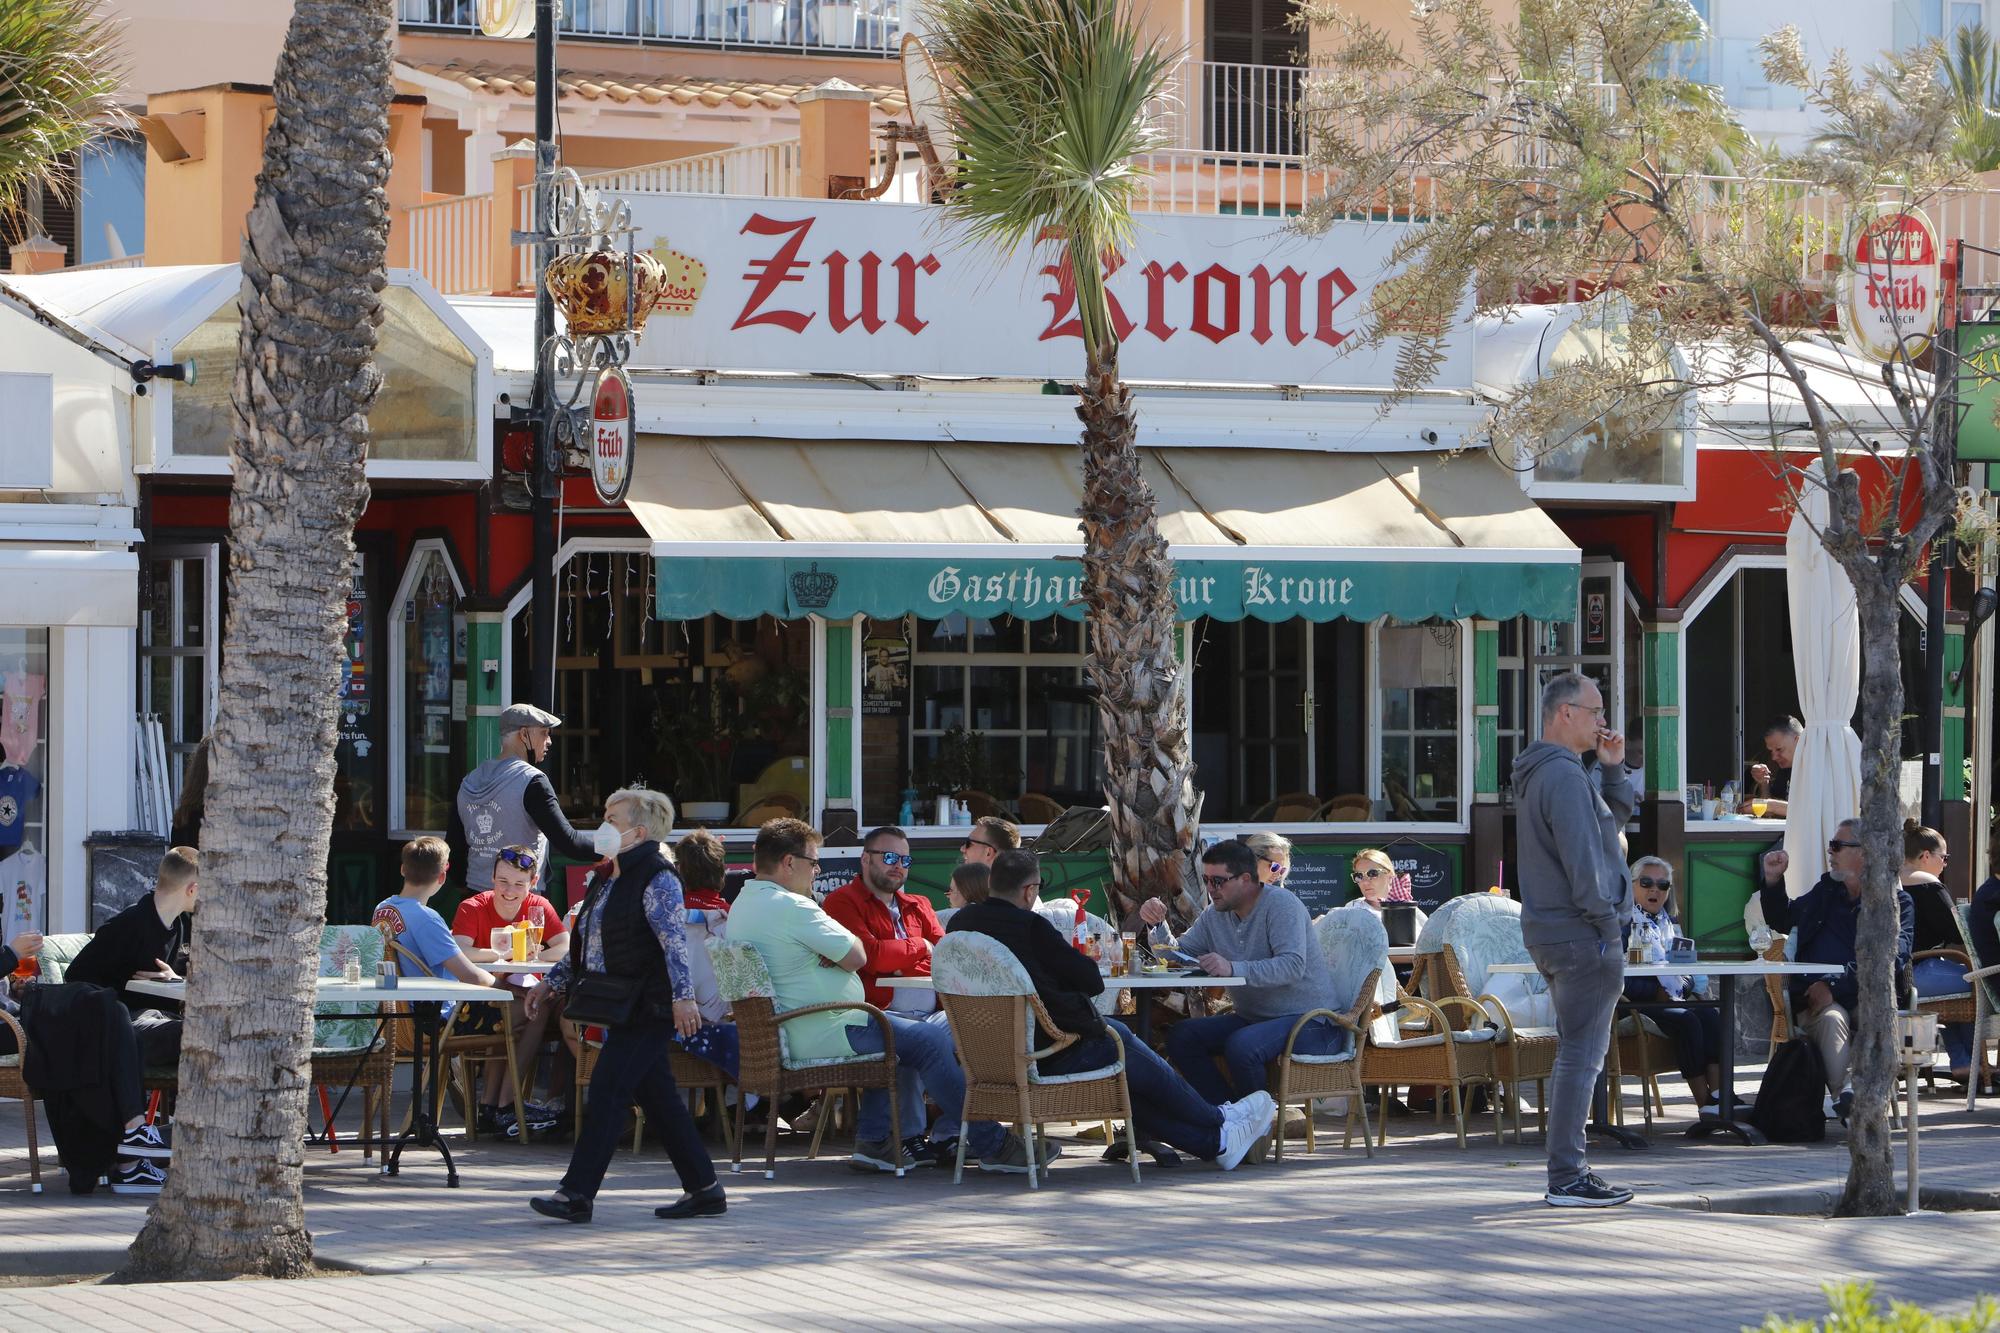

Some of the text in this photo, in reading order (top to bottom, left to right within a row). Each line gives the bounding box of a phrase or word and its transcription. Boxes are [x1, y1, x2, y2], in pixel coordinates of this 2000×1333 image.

[730, 213, 1358, 347] Zur Krone
[1879, 314, 1915, 324] KSCH
[928, 565, 1354, 608] Gasthau ur Krone
[351, 731, 367, 740] fun.
